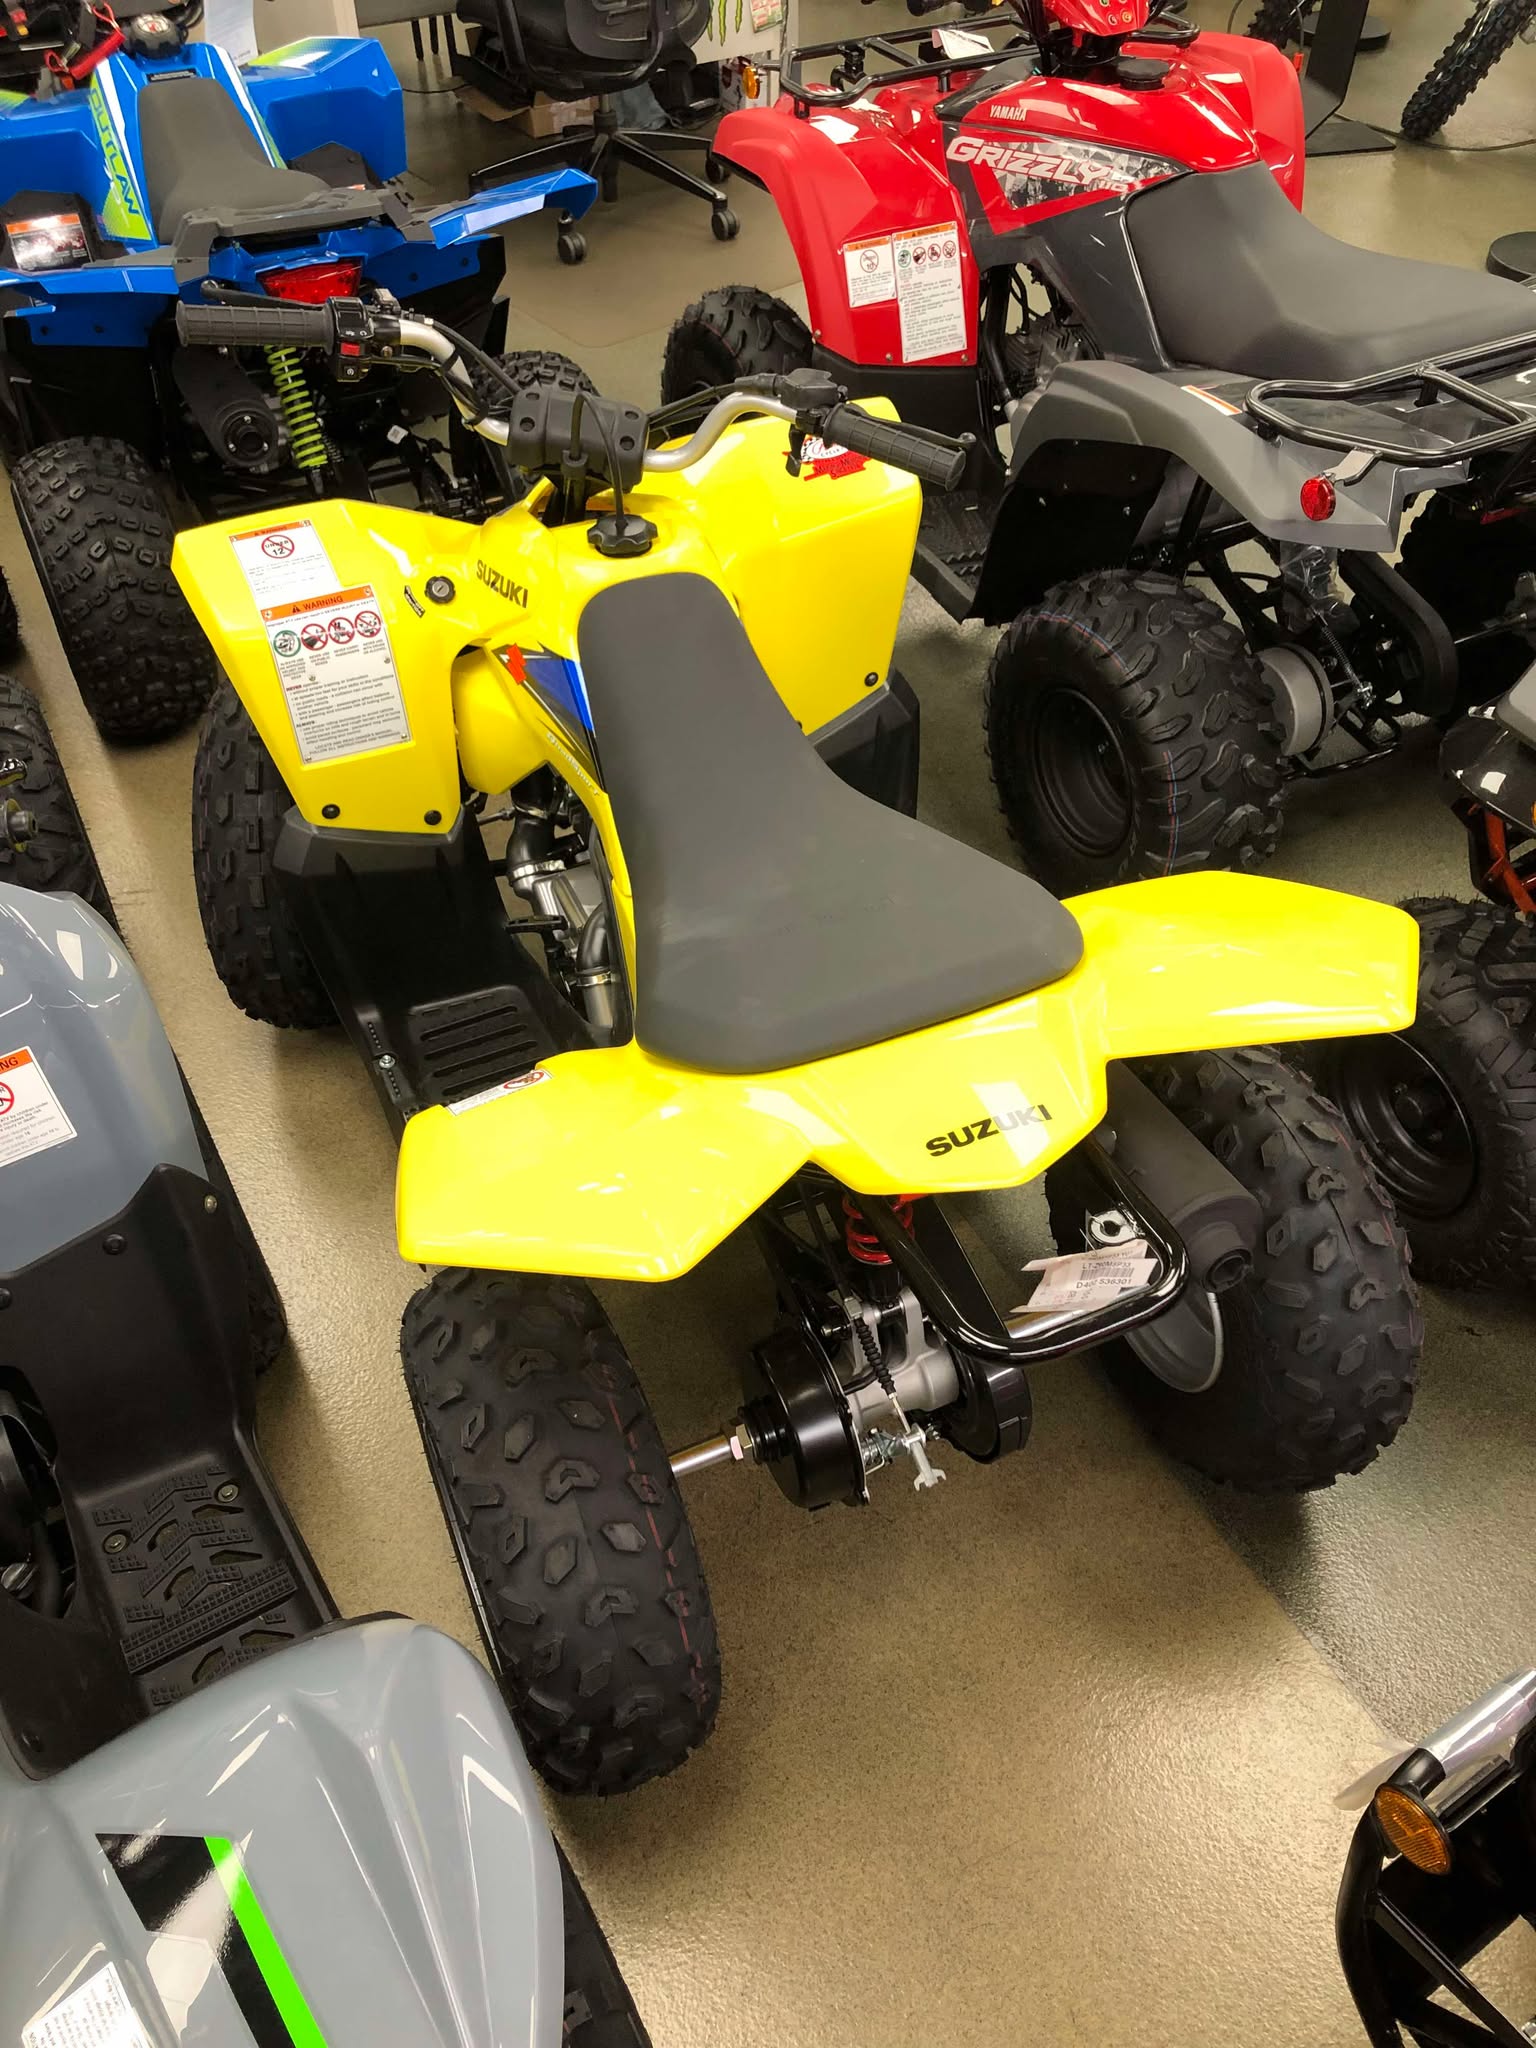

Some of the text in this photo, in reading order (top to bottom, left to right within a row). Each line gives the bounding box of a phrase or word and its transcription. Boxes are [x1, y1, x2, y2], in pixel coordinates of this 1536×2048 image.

[989, 104, 1027, 121] YAMAHA
[88, 87, 139, 214] OUTLAW
[946, 136, 1111, 186] GRIZZLY
[272, 548, 285, 556] 12
[302, 595, 344, 611] WARNING
[476, 559, 529, 609] SUZUKI
[926, 1104, 1053, 1157] SUZUKI
